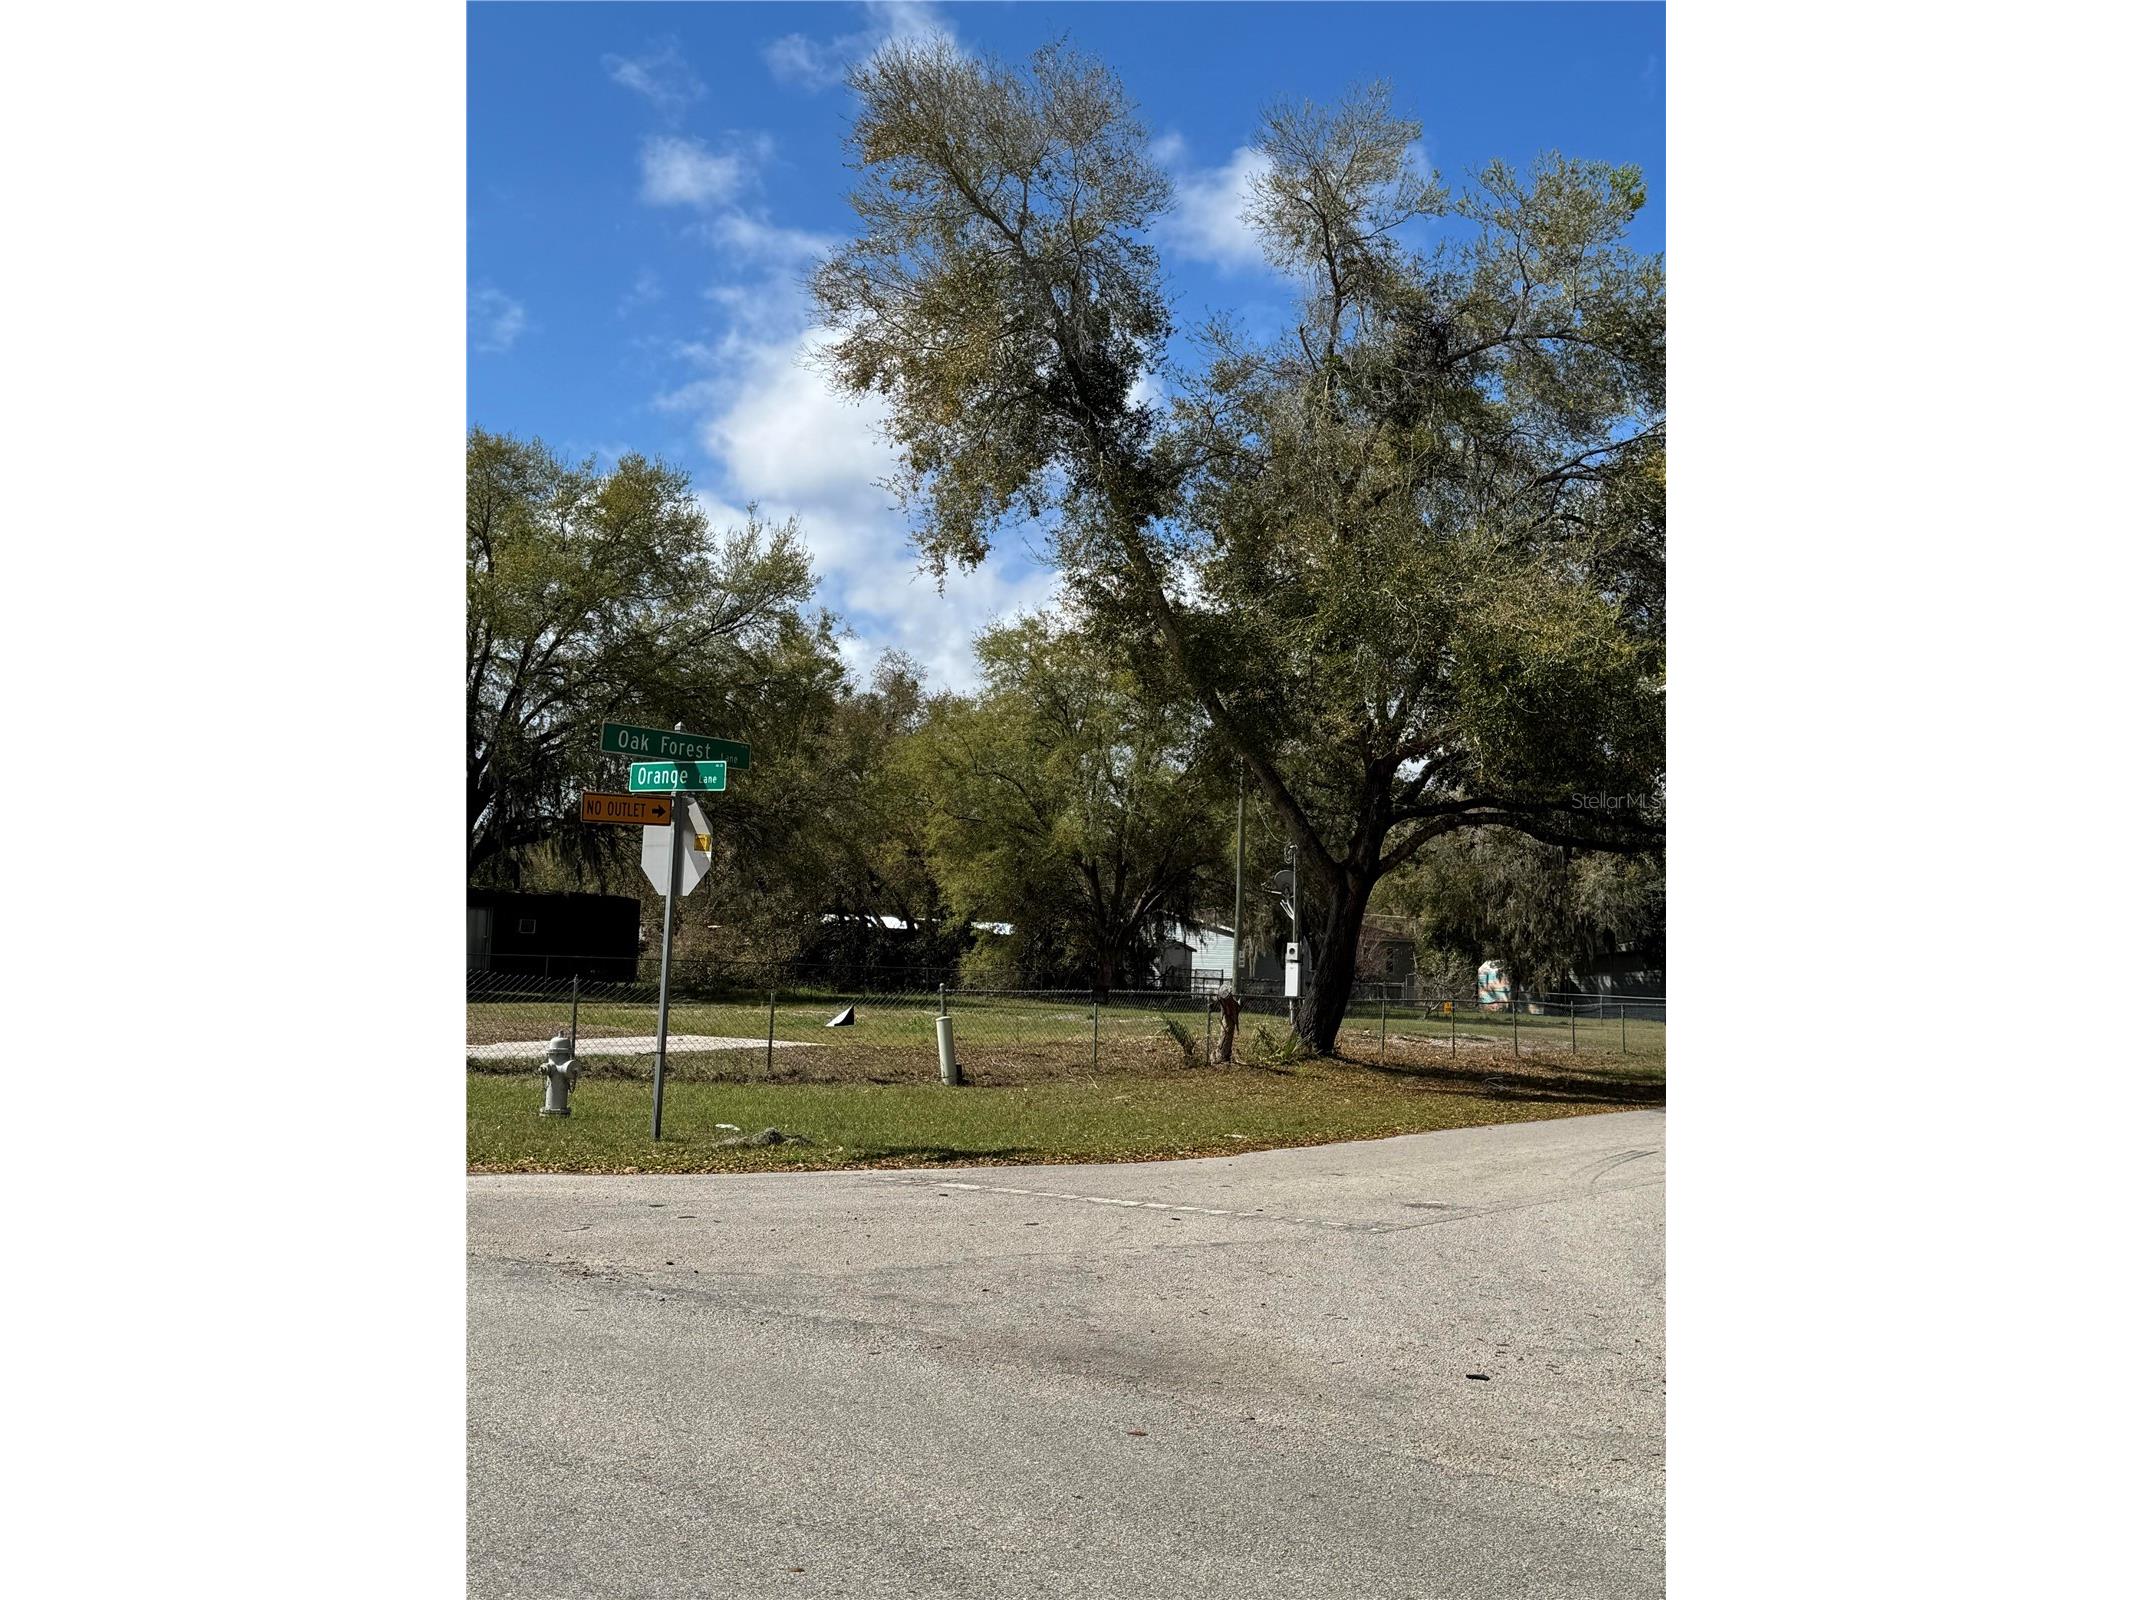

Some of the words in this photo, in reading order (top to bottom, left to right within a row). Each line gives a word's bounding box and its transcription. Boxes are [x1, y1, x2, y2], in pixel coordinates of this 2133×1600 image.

[618, 730, 649, 751] Oak
[660, 736, 711, 760] Forest
[637, 767, 688, 788] Orange
[698, 774, 717, 784] Lane
[586, 799, 602, 816] NO
[607, 801, 646, 817] OUTLET
